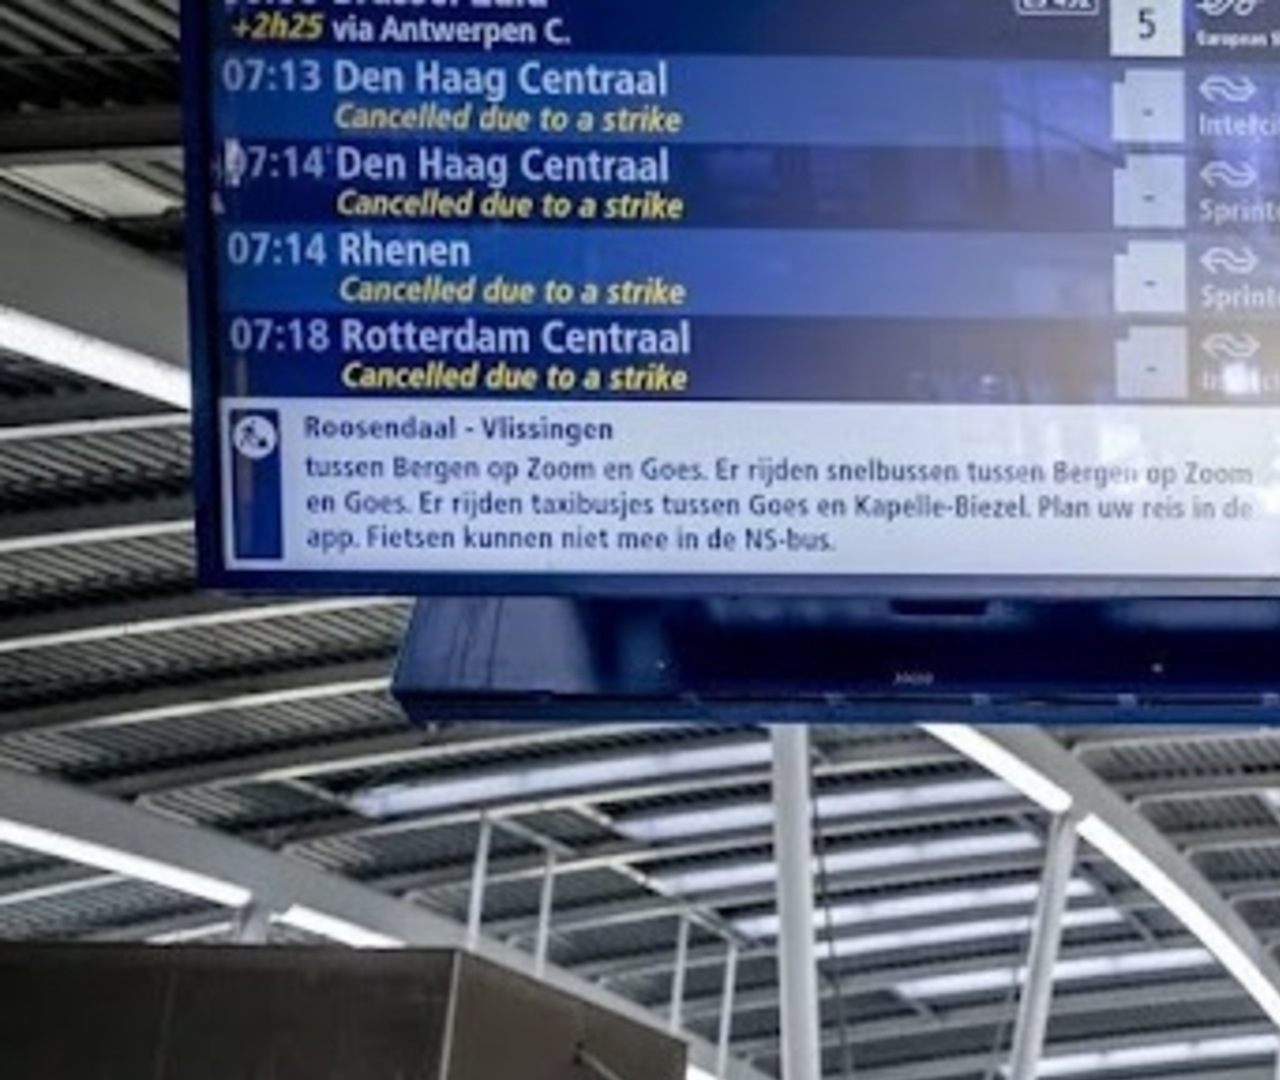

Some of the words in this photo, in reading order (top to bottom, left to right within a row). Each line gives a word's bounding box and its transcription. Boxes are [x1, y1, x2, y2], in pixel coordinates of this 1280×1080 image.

[233, 12, 323, 39] +2h25
[333, 16, 373, 41] via
[380, 16, 536, 50] Antwerpen
[544, 18, 570, 44] C.
[1139, 8, 1156, 39] 5
[223, 59, 321, 91] 07:13
[335, 60, 403, 92] Den
[417, 61, 506, 102] Haag
[519, 61, 667, 95] Centraal
[337, 146, 405, 179] Den
[420, 147, 507, 189] Haag
[521, 147, 668, 182] Centraal
[228, 232, 326, 264] 07:14
[341, 231, 470, 266] Rhenen
[231, 318, 329, 351] 07:18
[342, 318, 529, 352] Rotterdam
[542, 320, 689, 353] Centraal
[342, 361, 479, 388] Cancelled
[486, 362, 538, 389] due
[548, 366, 575, 390] to
[583, 369, 600, 390] a
[609, 364, 687, 390] strike
[305, 416, 455, 439] Roosendaal
[482, 416, 613, 445] Vlissingen
[305, 456, 383, 478] tussen
[393, 456, 480, 484] Bergen
[487, 461, 519, 485] op
[527, 457, 595, 480] Zoom
[604, 463, 633, 480] en
[641, 457, 707, 481] Goes.
[716, 457, 739, 481] Er
[749, 458, 818, 487] rijden
[827, 458, 959, 481] snelbussen
[967, 462, 1045, 483] tussen
[1054, 461, 1137, 489] Bergen
[1146, 464, 1177, 490] op
[1186, 462, 1252, 484] Zoom
[306, 495, 335, 513] en
[344, 491, 410, 514] Goes.
[419, 491, 443, 514] Er
[452, 491, 522, 519] rijden
[531, 491, 653, 521] taxibusjes
[662, 495, 740, 515] tussen
[749, 494, 809, 516] Goes
[817, 499, 846, 517] en
[855, 494, 1030, 522] Kapelle-Biezel.
[1039, 495, 1089, 518] Plan
[1098, 500, 1133, 518] uw
[1143, 497, 1184, 518] reis
[1194, 496, 1216, 518] in
[1223, 497, 1251, 518] de
[306, 531, 357, 552] app.
[367, 525, 454, 548] Fietsen
[464, 525, 552, 548] kunnen
[562, 525, 608, 548] niet
[618, 532, 668, 549] mee
[678, 526, 699, 549] in
[708, 527, 736, 550] de
[745, 528, 836, 551] NS-bus.
